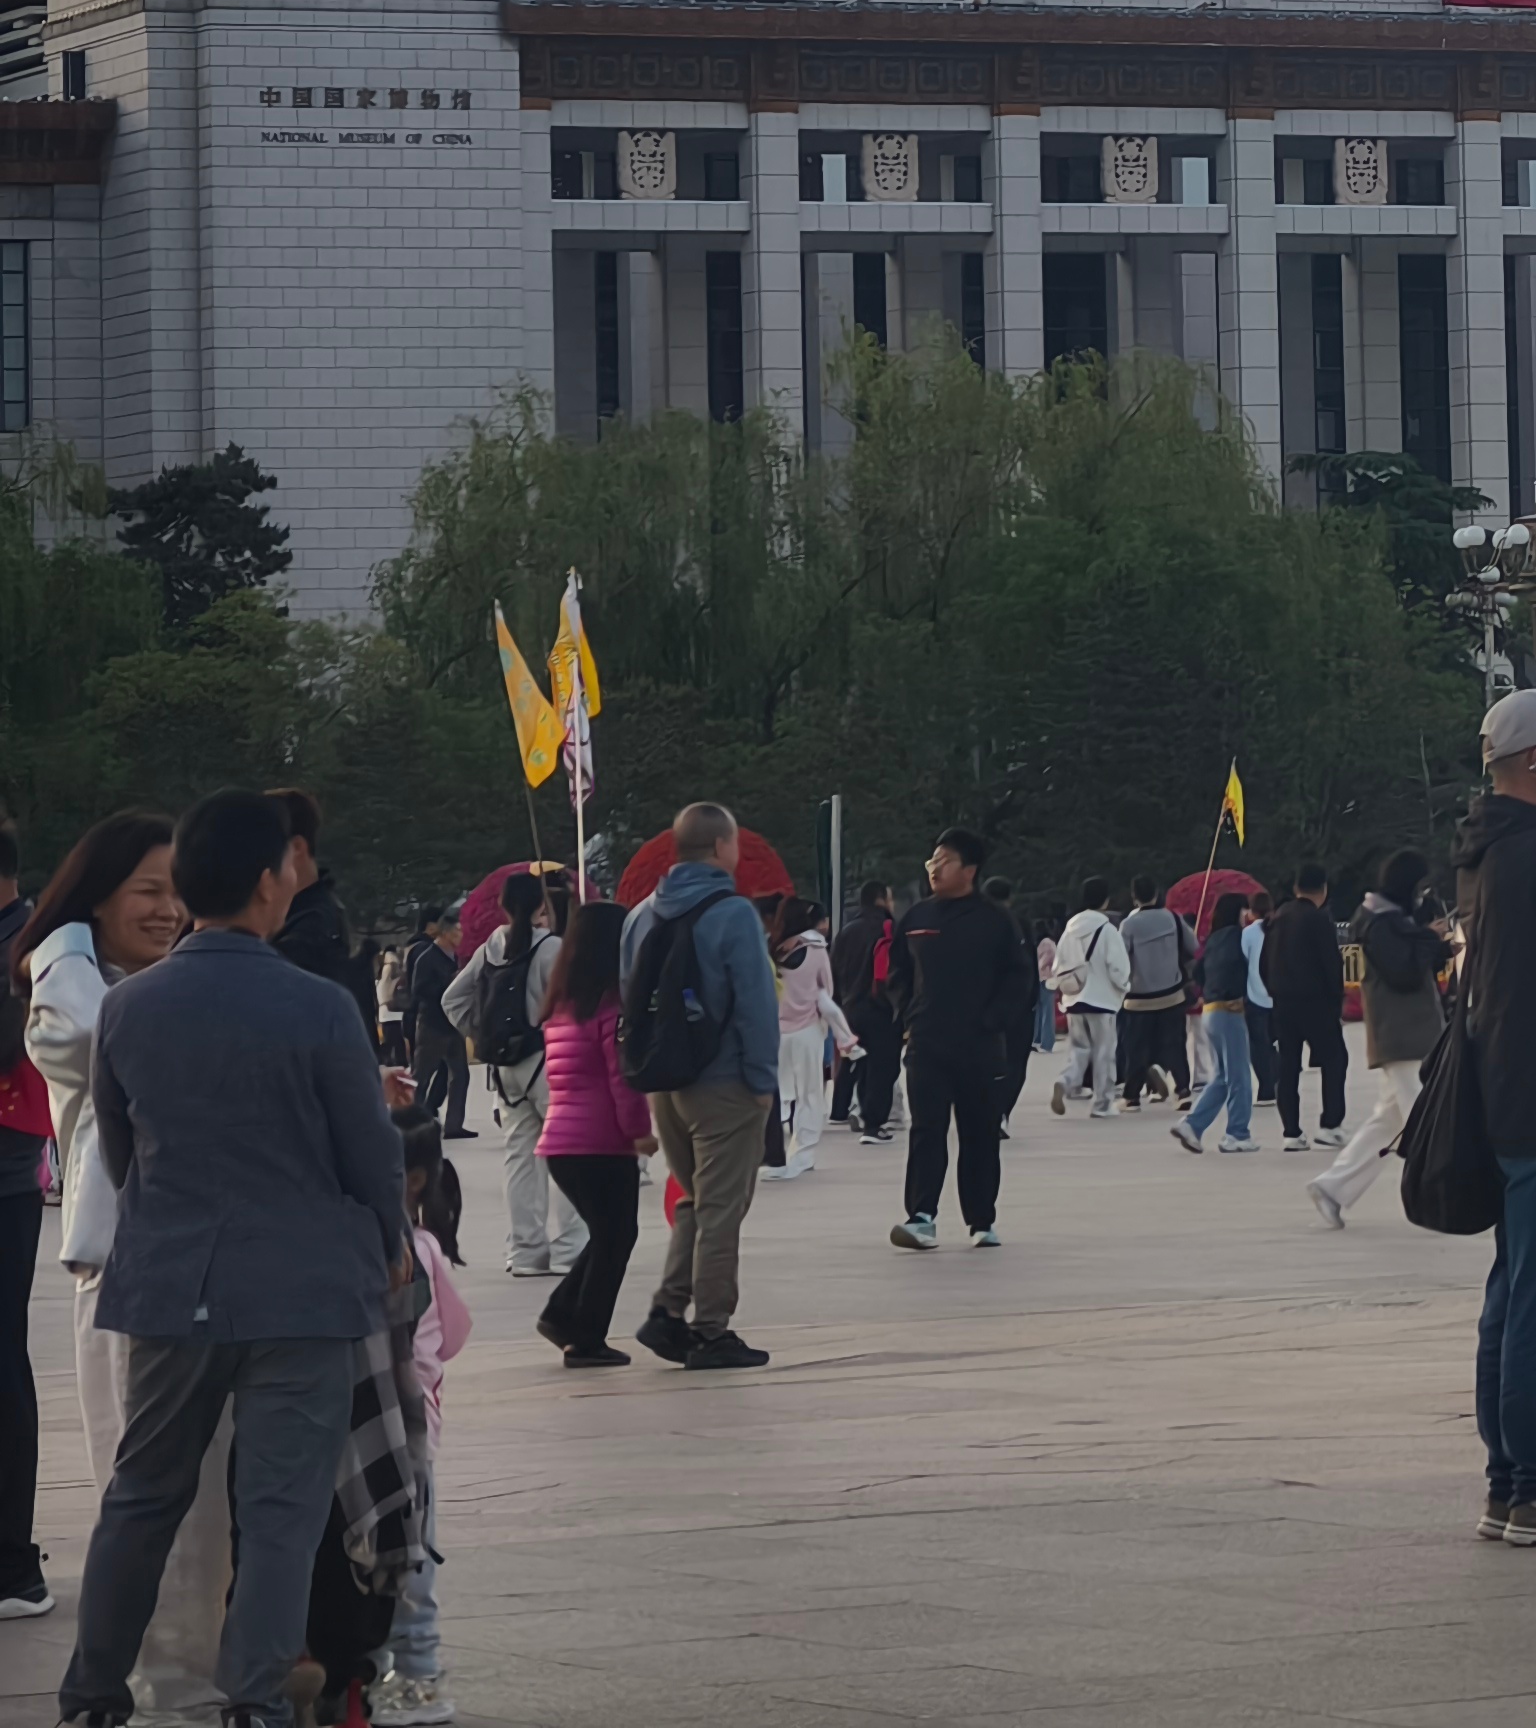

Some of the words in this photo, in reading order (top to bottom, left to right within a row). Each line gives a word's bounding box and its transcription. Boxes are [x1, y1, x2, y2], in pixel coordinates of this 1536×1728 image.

[261, 132, 328, 144] NATIONAL
[338, 132, 395, 144] MUSEUM
[405, 133, 422, 145] OF
